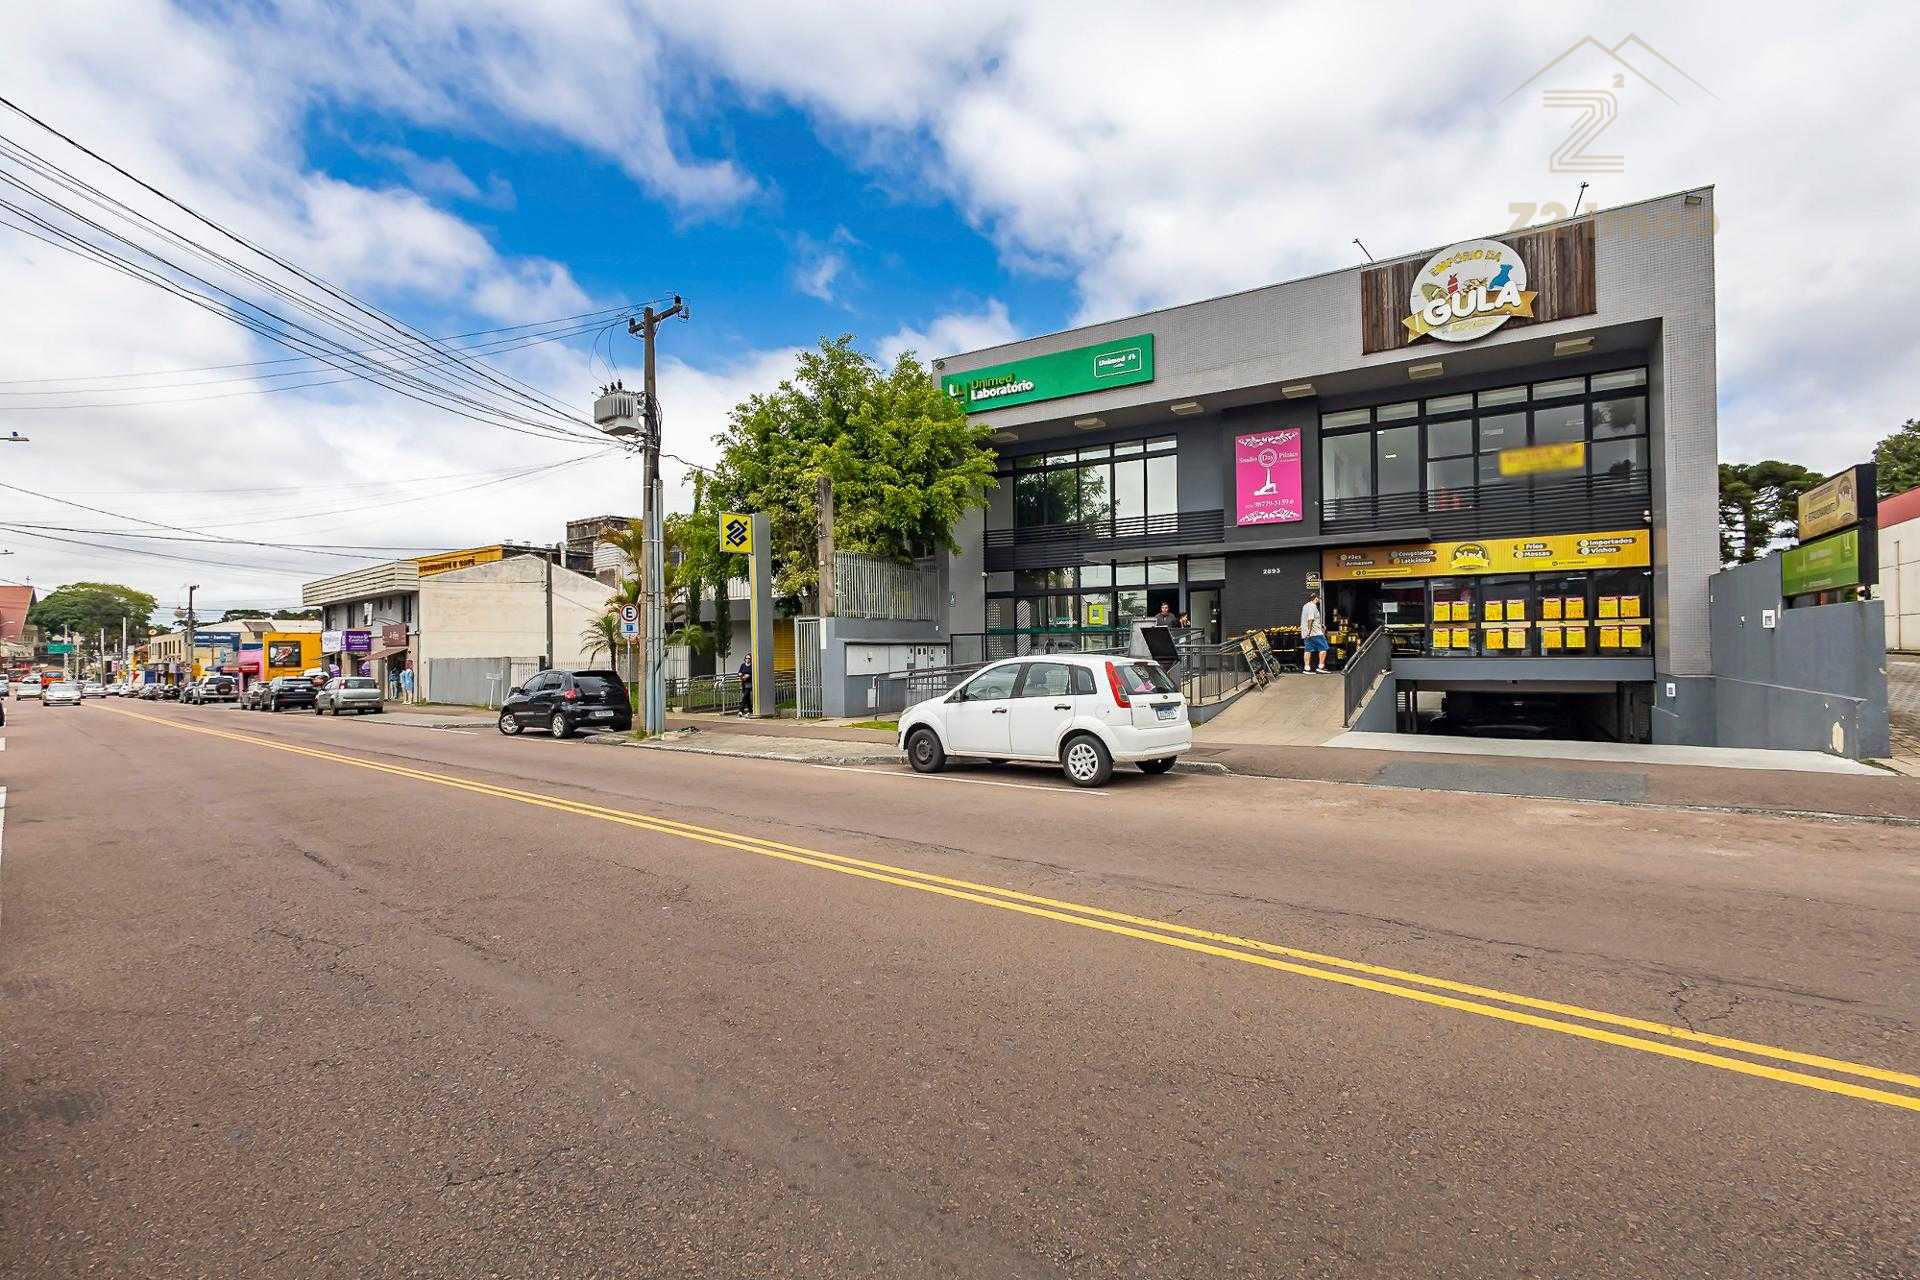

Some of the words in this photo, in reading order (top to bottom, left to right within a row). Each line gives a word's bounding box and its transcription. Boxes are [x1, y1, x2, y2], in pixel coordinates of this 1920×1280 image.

[1423, 279, 1521, 327] GULA
[971, 374, 1015, 390] Unimed
[970, 380, 1034, 401] Laboratório
[1589, 537, 1633, 548] Importados
[1590, 546, 1618, 554] Vinhos
[625, 607, 633, 619] E
